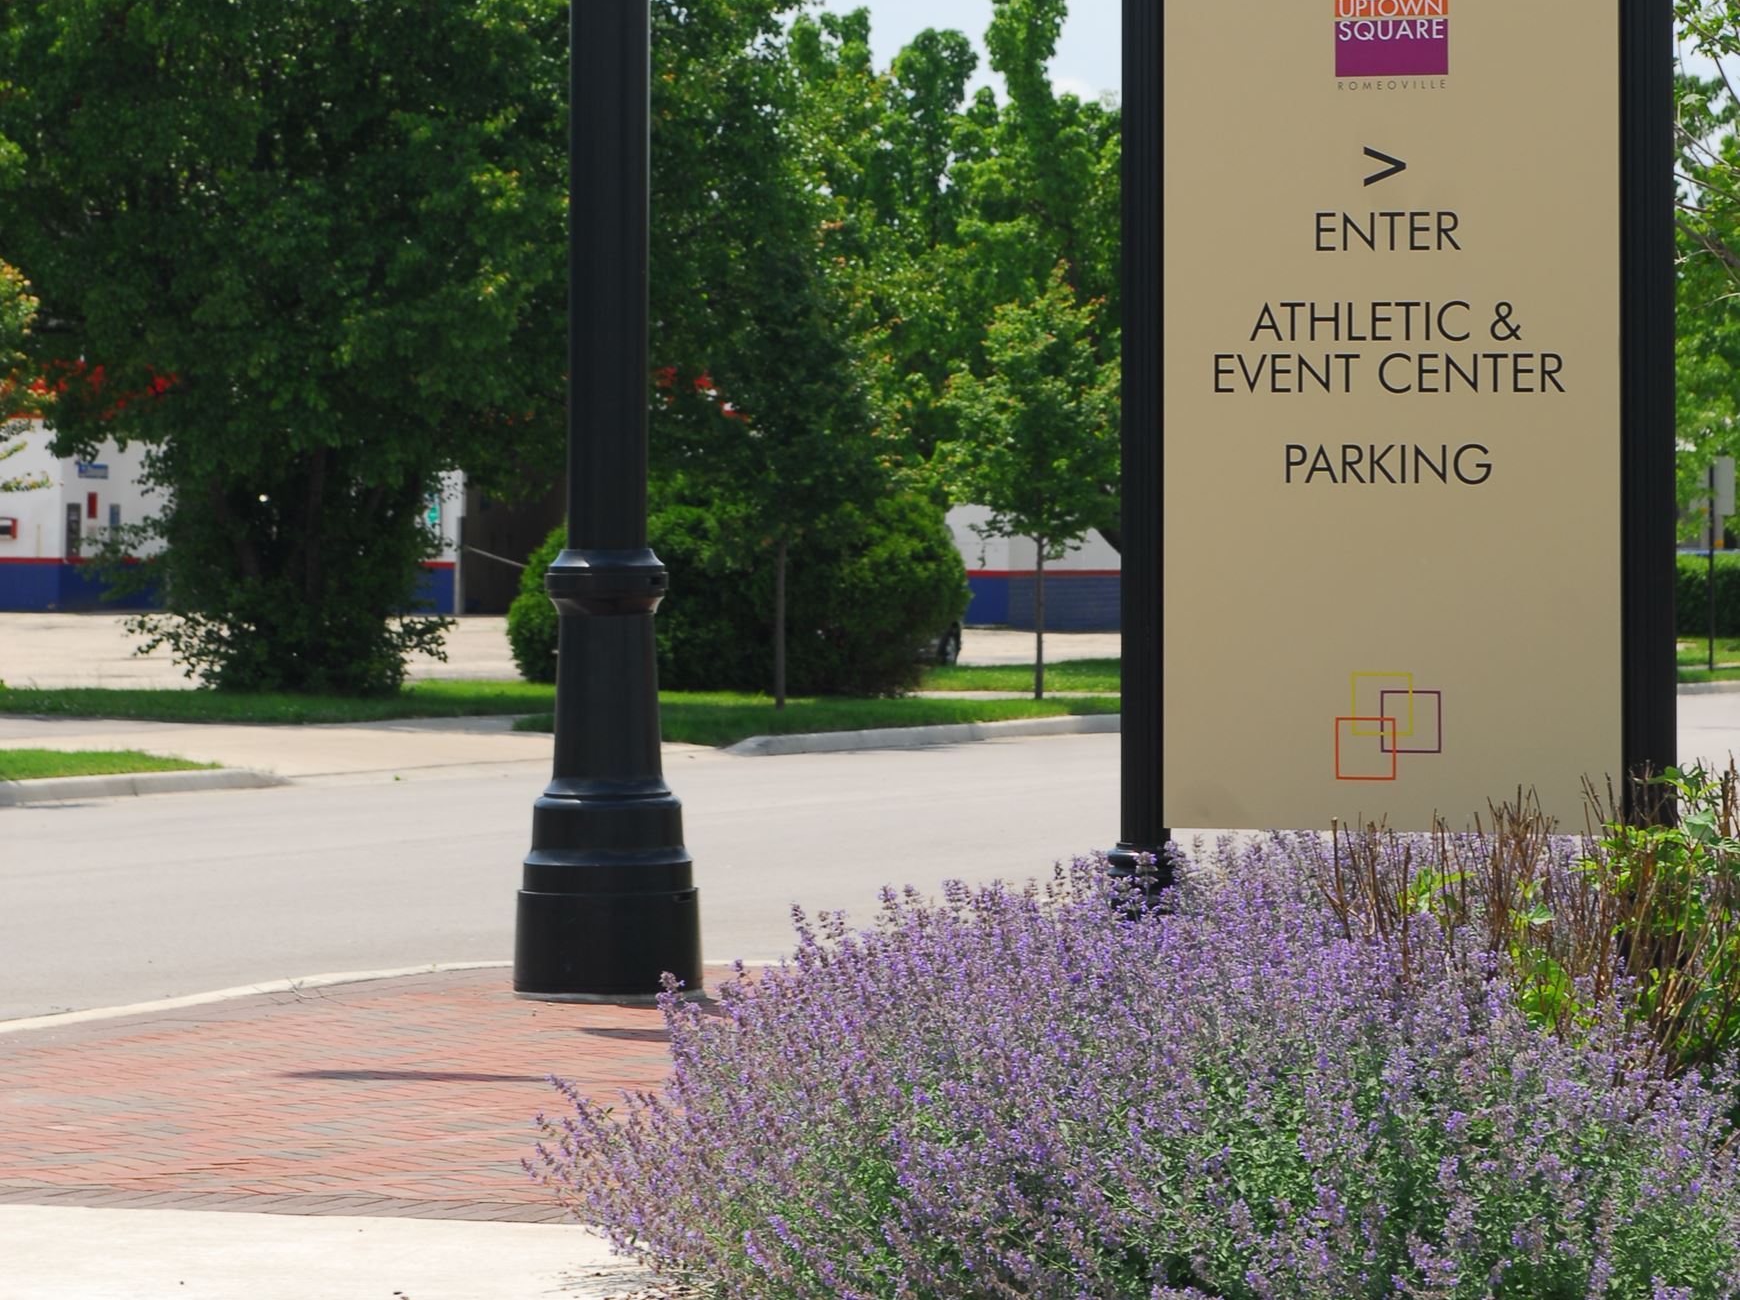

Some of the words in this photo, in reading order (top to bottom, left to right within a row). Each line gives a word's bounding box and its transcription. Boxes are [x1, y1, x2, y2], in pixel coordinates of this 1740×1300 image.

[1338, 18, 1444, 41] SQUARE
[1337, 79, 1446, 91] ROMEOVILLE
[1315, 211, 1462, 252] ENTER
[1249, 300, 1471, 342] ATHLETIC
[1489, 300, 1523, 341] &
[1213, 353, 1361, 394] EVENT
[1377, 352, 1567, 394] CENTER
[1284, 443, 1493, 485] PARKING
